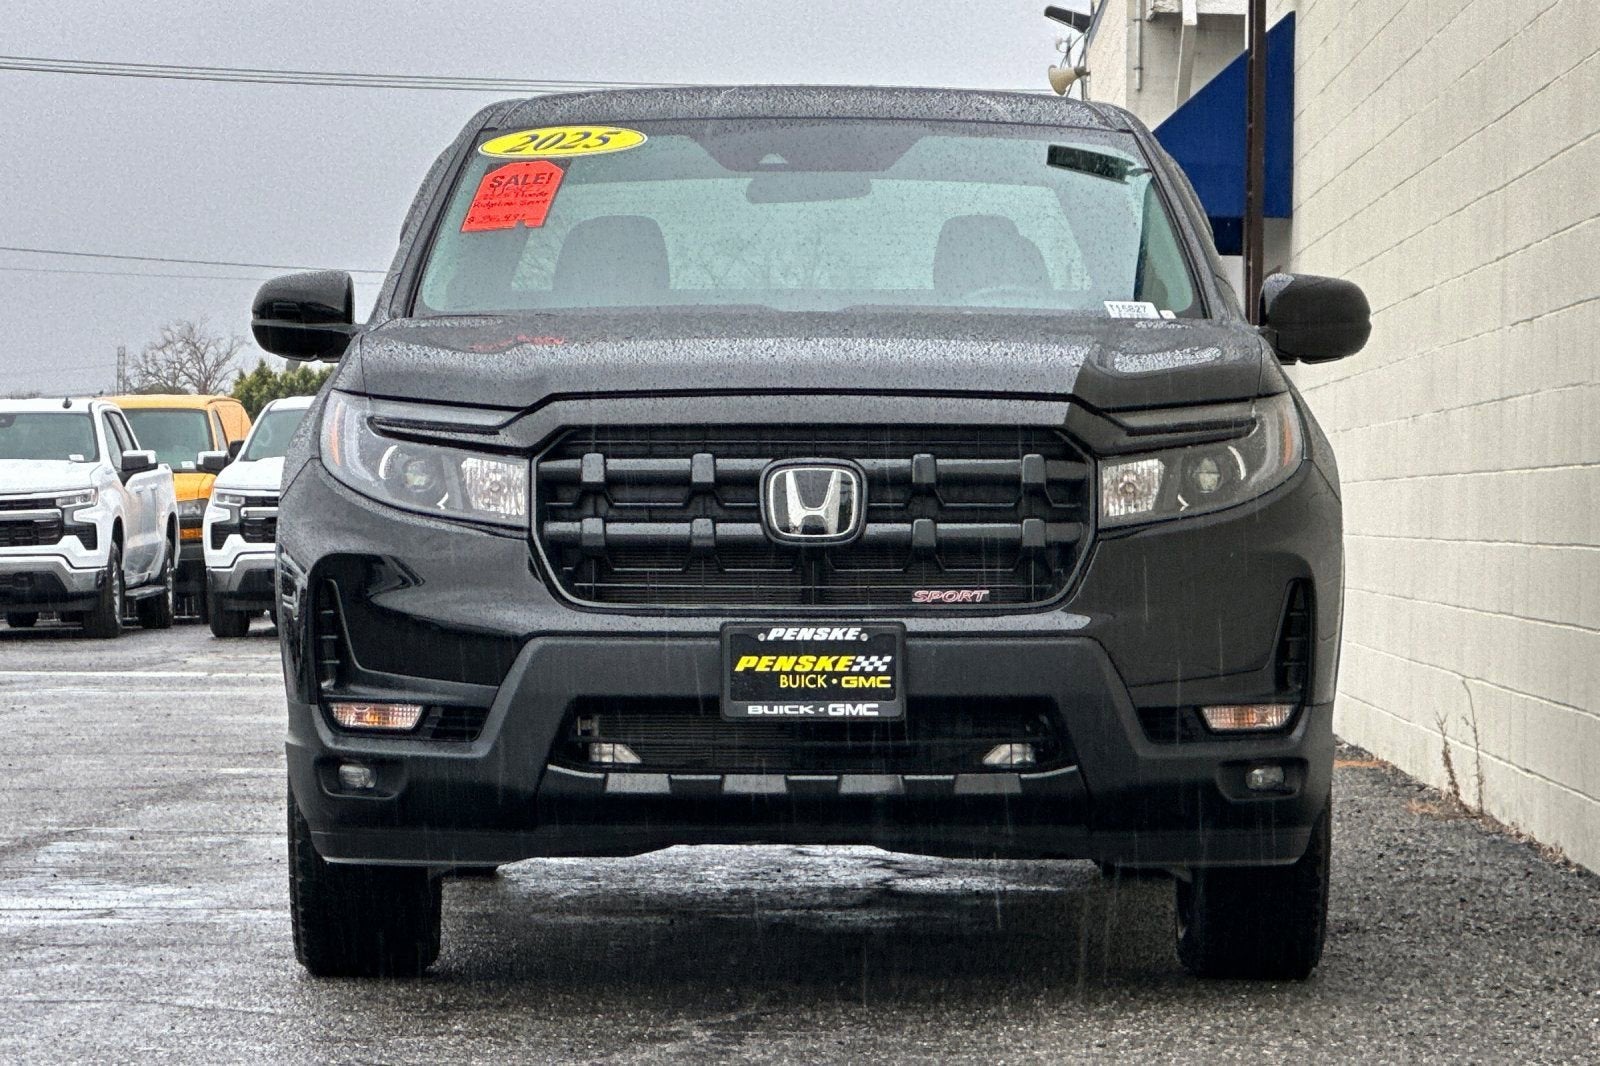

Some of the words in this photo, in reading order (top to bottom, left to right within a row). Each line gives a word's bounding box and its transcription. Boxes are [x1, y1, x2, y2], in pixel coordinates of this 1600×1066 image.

[503, 131, 622, 153] 2025
[489, 172, 555, 188] SALE!
[1108, 303, 1147, 314] T15827
[912, 589, 990, 603] SPORT
[766, 627, 862, 641] PENSKE
[734, 655, 858, 672] PENSKE
[779, 674, 828, 688] BUICK
[841, 675, 892, 688] GMC
[747, 705, 815, 715] BUICK
[827, 703, 879, 716] GMC
